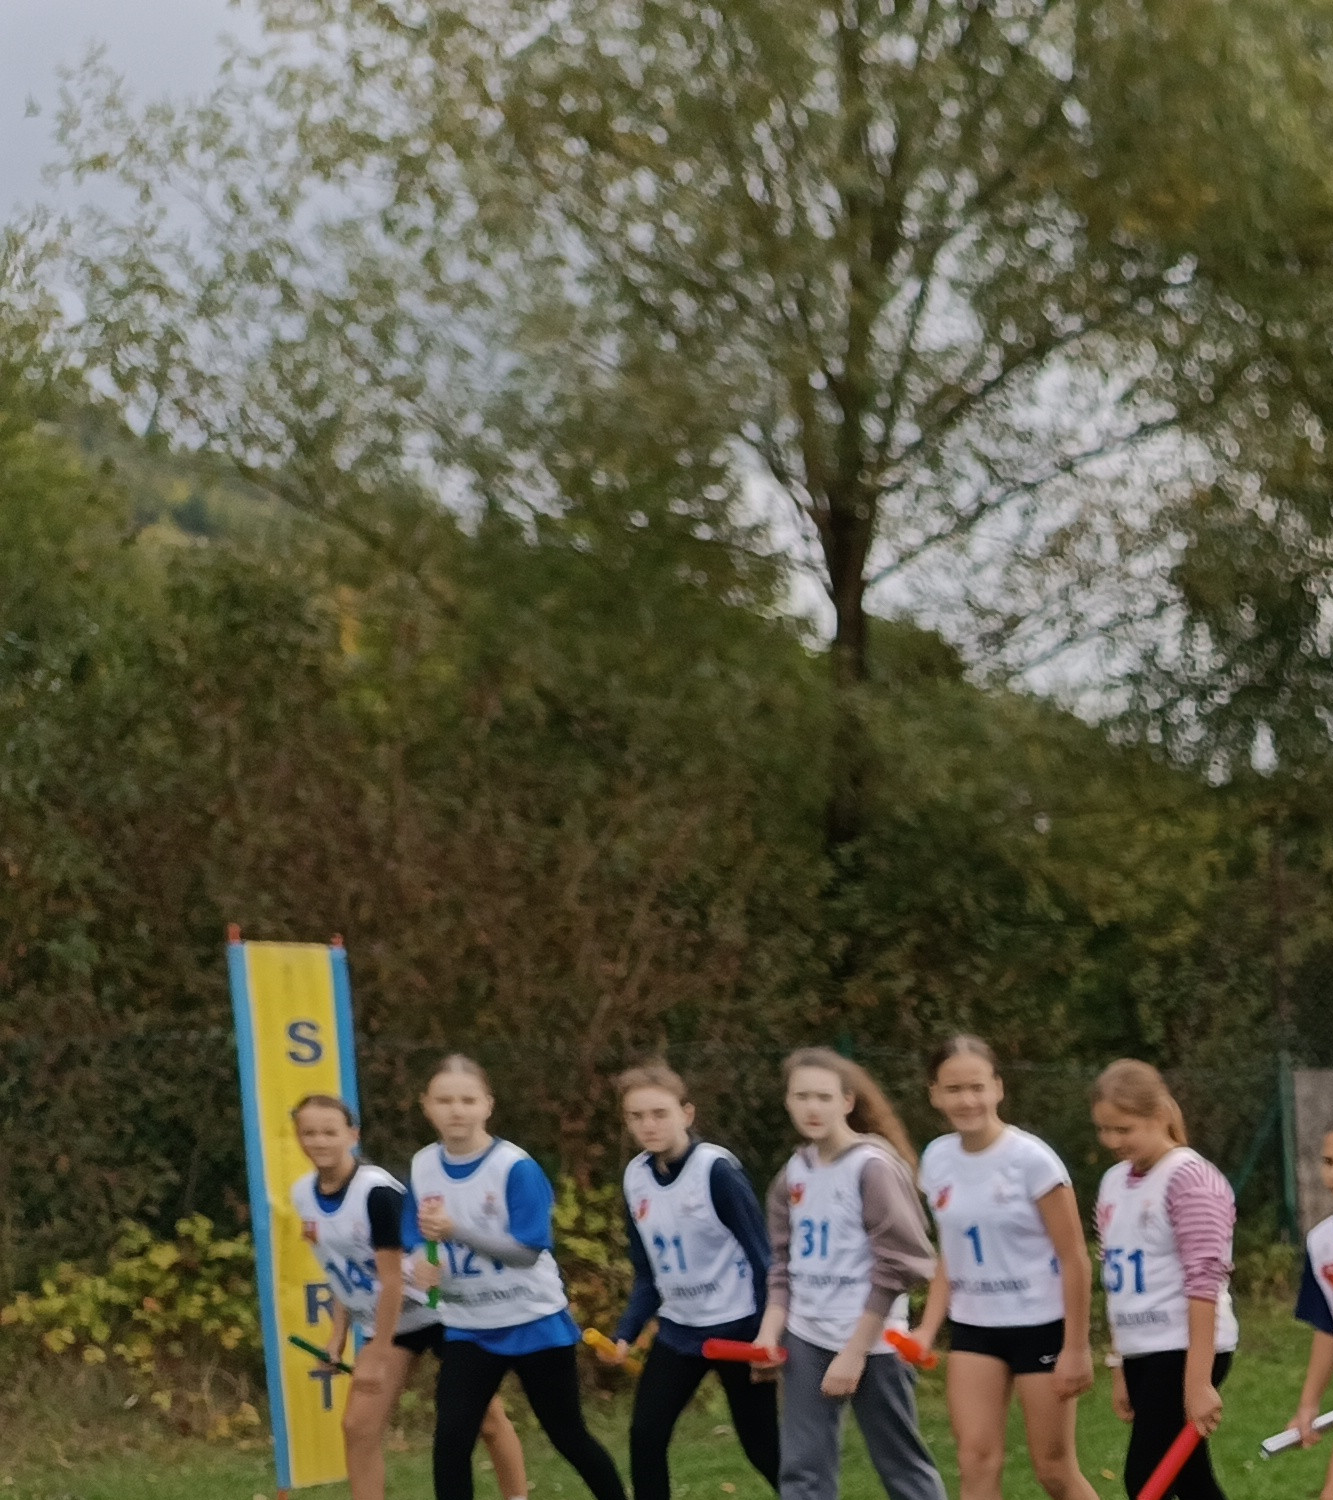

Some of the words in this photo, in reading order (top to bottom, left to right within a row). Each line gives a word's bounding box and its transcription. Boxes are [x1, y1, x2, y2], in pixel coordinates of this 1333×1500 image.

[287, 1020, 343, 1411] SRT
[653, 1233, 687, 1273] 21
[800, 1218, 830, 1259] 31
[966, 1226, 984, 1265] 1
[1104, 1248, 1146, 1293] 51
